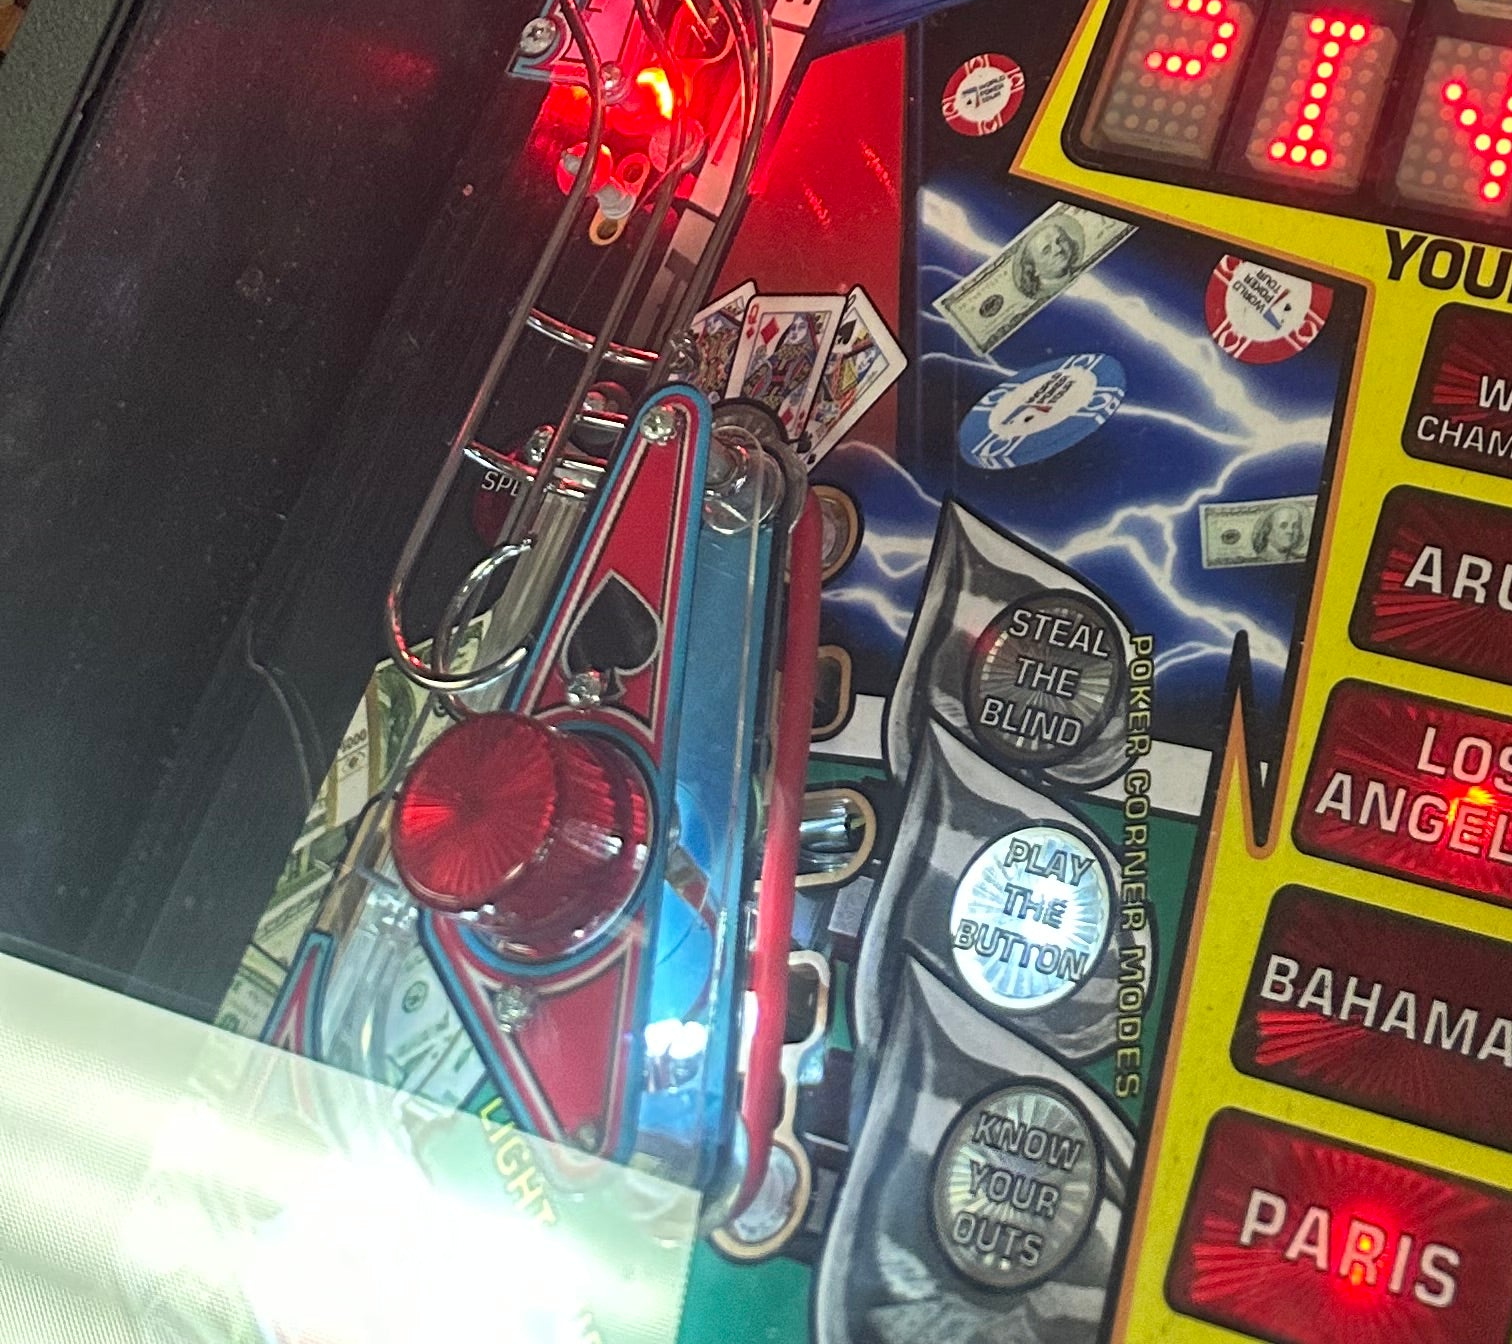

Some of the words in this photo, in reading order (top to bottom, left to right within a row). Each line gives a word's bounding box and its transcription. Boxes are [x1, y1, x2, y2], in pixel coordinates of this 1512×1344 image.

[1007, 609, 1112, 658] STEAL
[1012, 656, 1077, 697] THE
[1122, 633, 1153, 755] POKER
[978, 698, 1084, 748] BLIND
[1004, 836, 1095, 889] PLAY
[1119, 768, 1152, 932] CORNER
[1003, 888, 1064, 929] THE
[953, 919, 1088, 983] BUTTON
[1113, 944, 1149, 1101] MODES
[969, 1112, 1084, 1171] KNOW
[967, 1161, 1061, 1220] YOUR
[952, 1208, 1044, 1267] OUTS
[1239, 1188, 1462, 1309] PARIS
